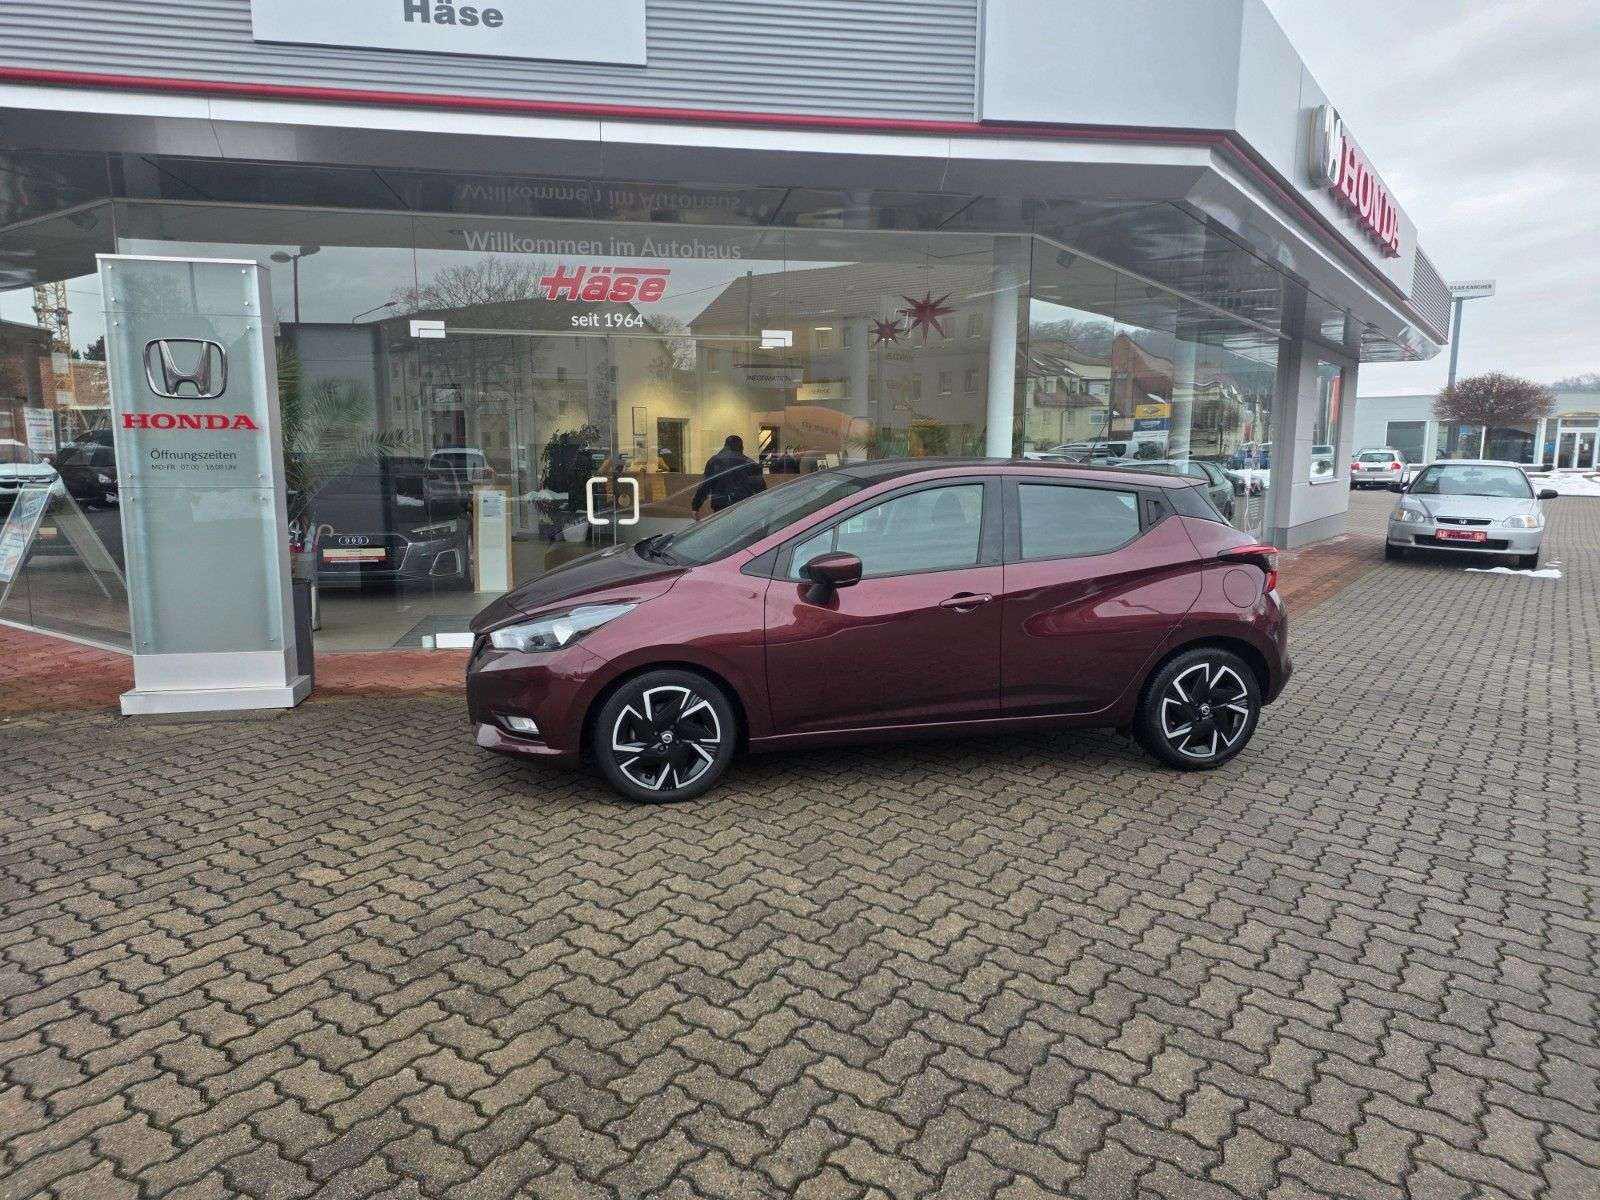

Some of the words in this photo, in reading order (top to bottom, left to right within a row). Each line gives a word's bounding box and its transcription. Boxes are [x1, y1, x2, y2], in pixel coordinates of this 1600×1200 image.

[403, 0, 504, 28] Häse
[1333, 135, 1400, 257] HONDA
[463, 229, 603, 255] Willkommen
[610, 236, 635, 256] im
[641, 237, 742, 259] Autohaus
[539, 264, 671, 303] Häse
[571, 312, 600, 327] seit
[604, 312, 644, 328] 1964
[122, 413, 259, 430] HONDA
[150, 447, 237, 462] Öffnungszeiten
